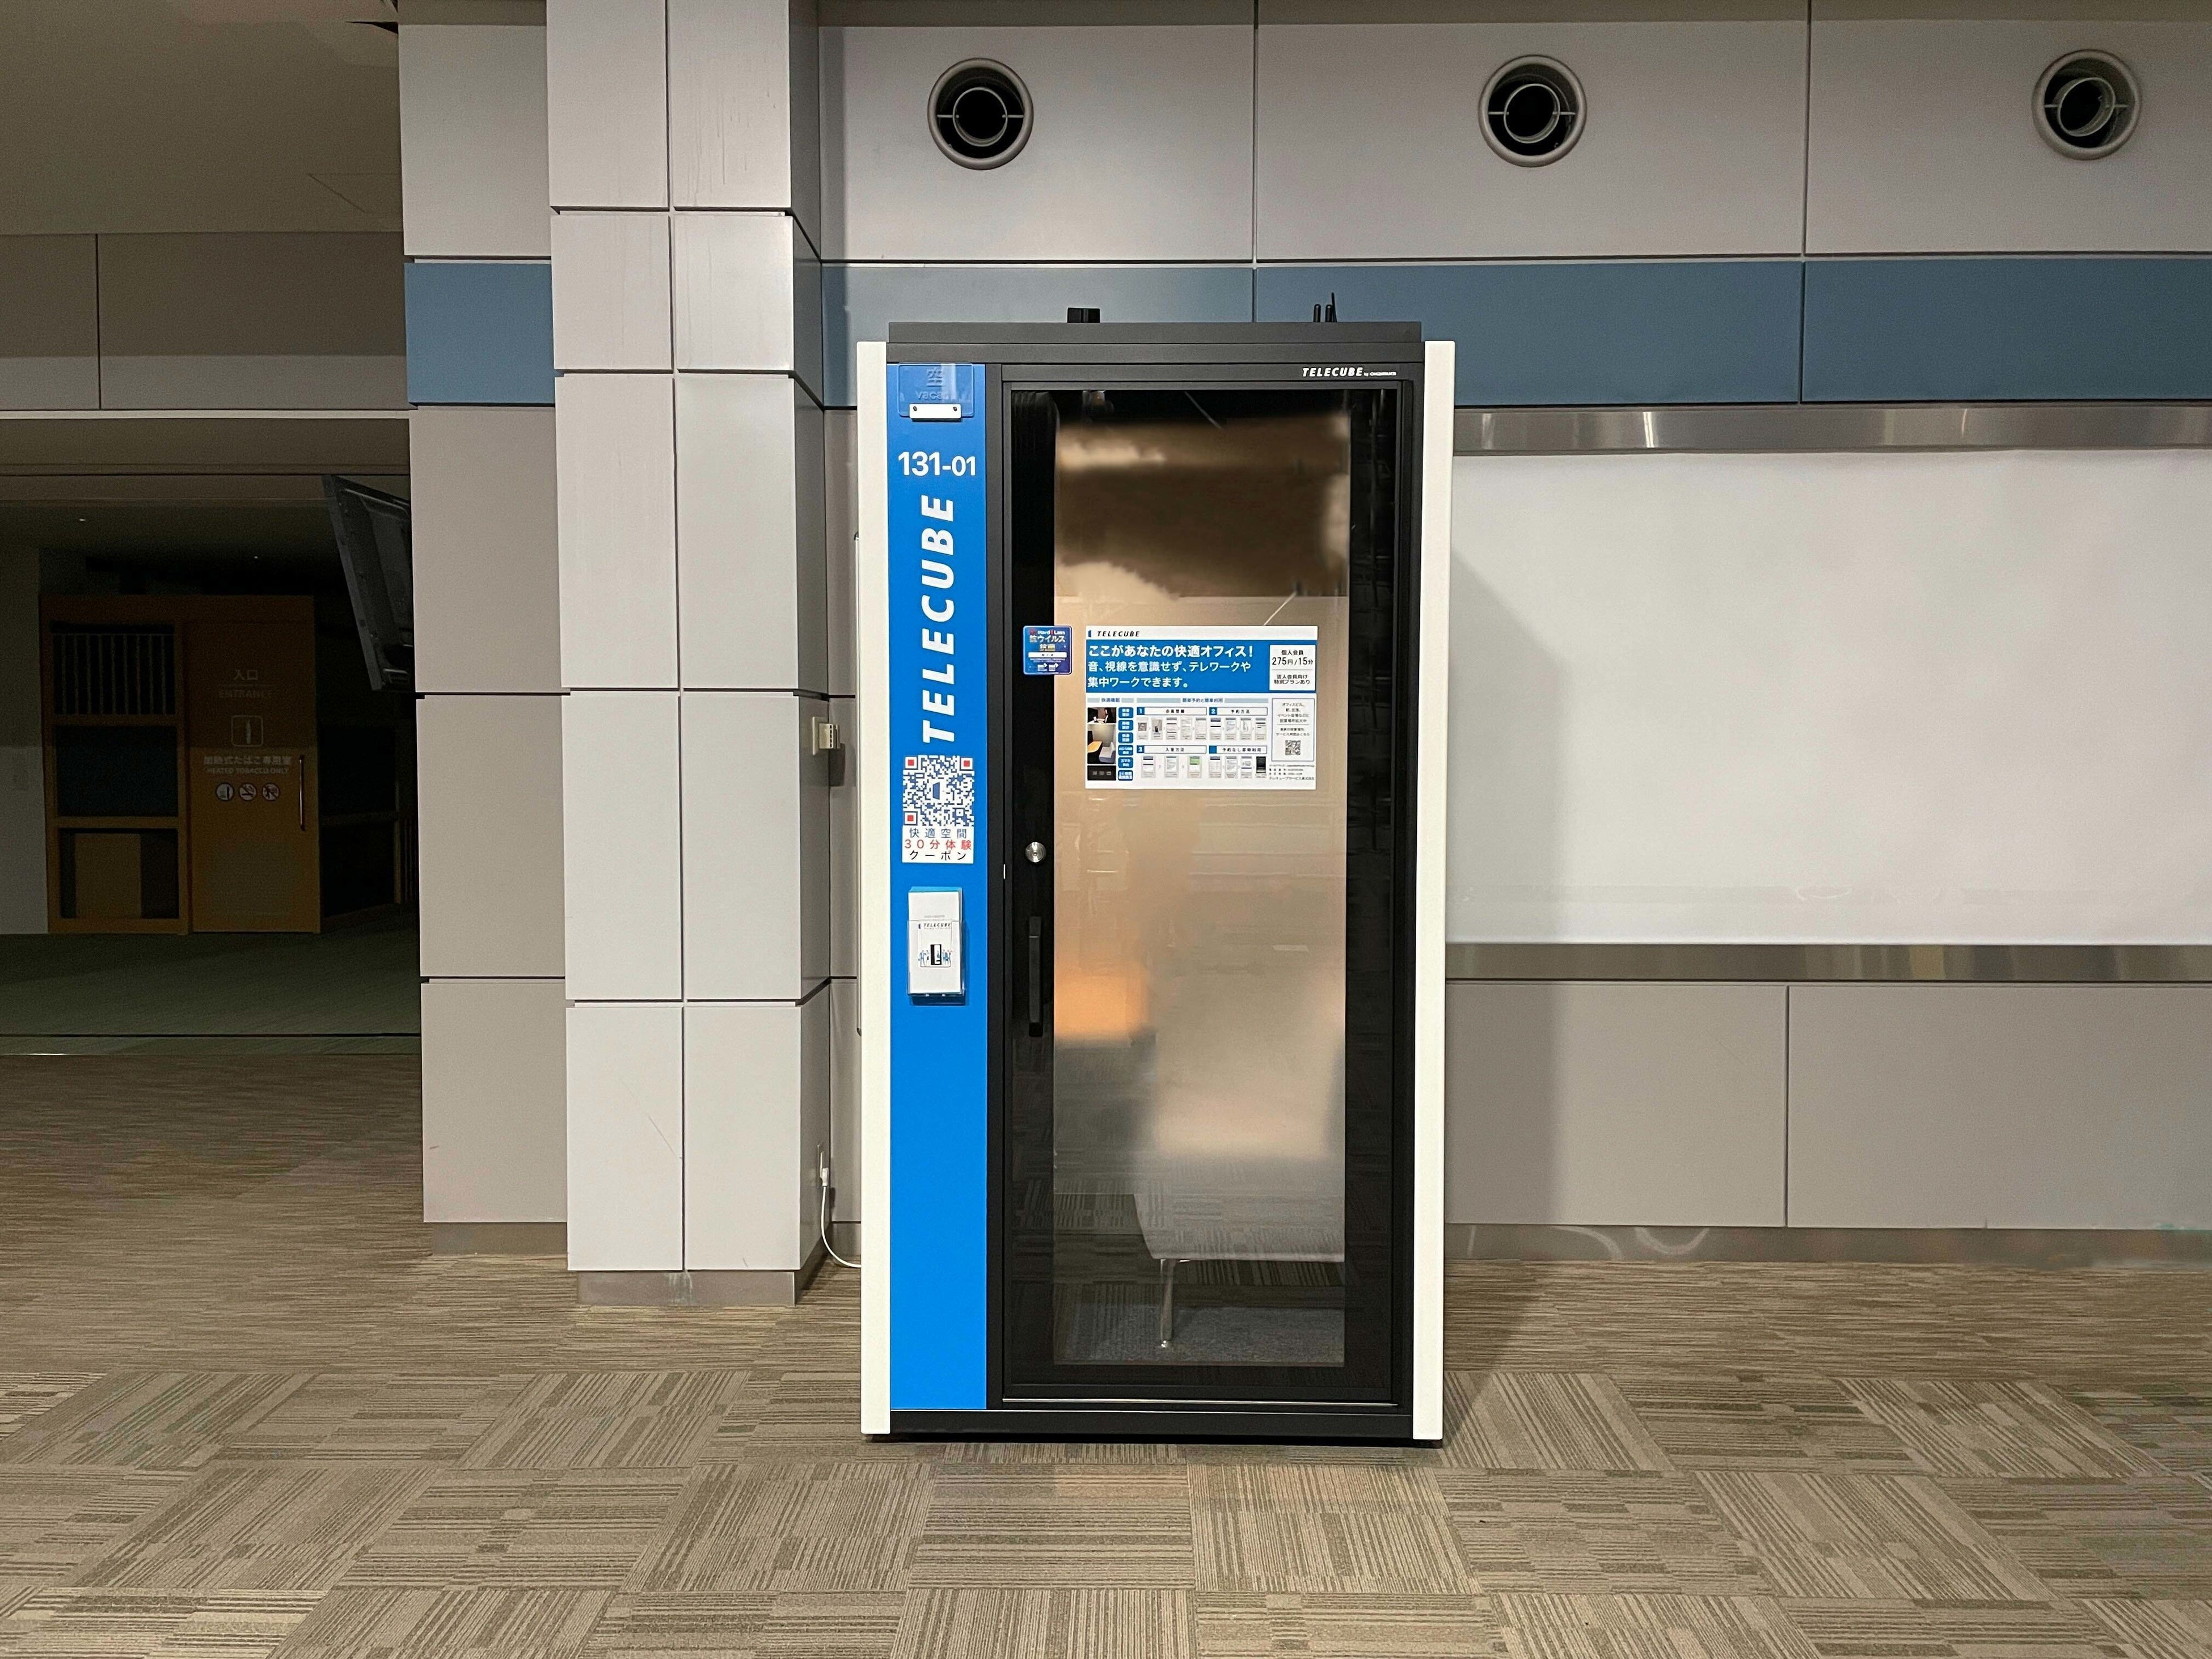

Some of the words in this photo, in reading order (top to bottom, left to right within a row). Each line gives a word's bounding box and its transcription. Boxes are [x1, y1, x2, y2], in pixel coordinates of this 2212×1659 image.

[1302, 366, 1363, 377] TELECUBE
[898, 451, 976, 476] 131-01
[921, 494, 955, 744] TELECUBE
[1088, 644, 1253, 658] ここがあなたの快適オフィス!
[1087, 660, 1251, 673] 音、視線を意識せず、テレワークや
[233, 669, 259, 681] 入口
[1087, 676, 1189, 689] 集中ワークできます。
[218, 689, 273, 698] ENTRANCE
[909, 828, 967, 838] 快適空間
[904, 839, 972, 850] 30分体験
[909, 850, 967, 861] クーポン
